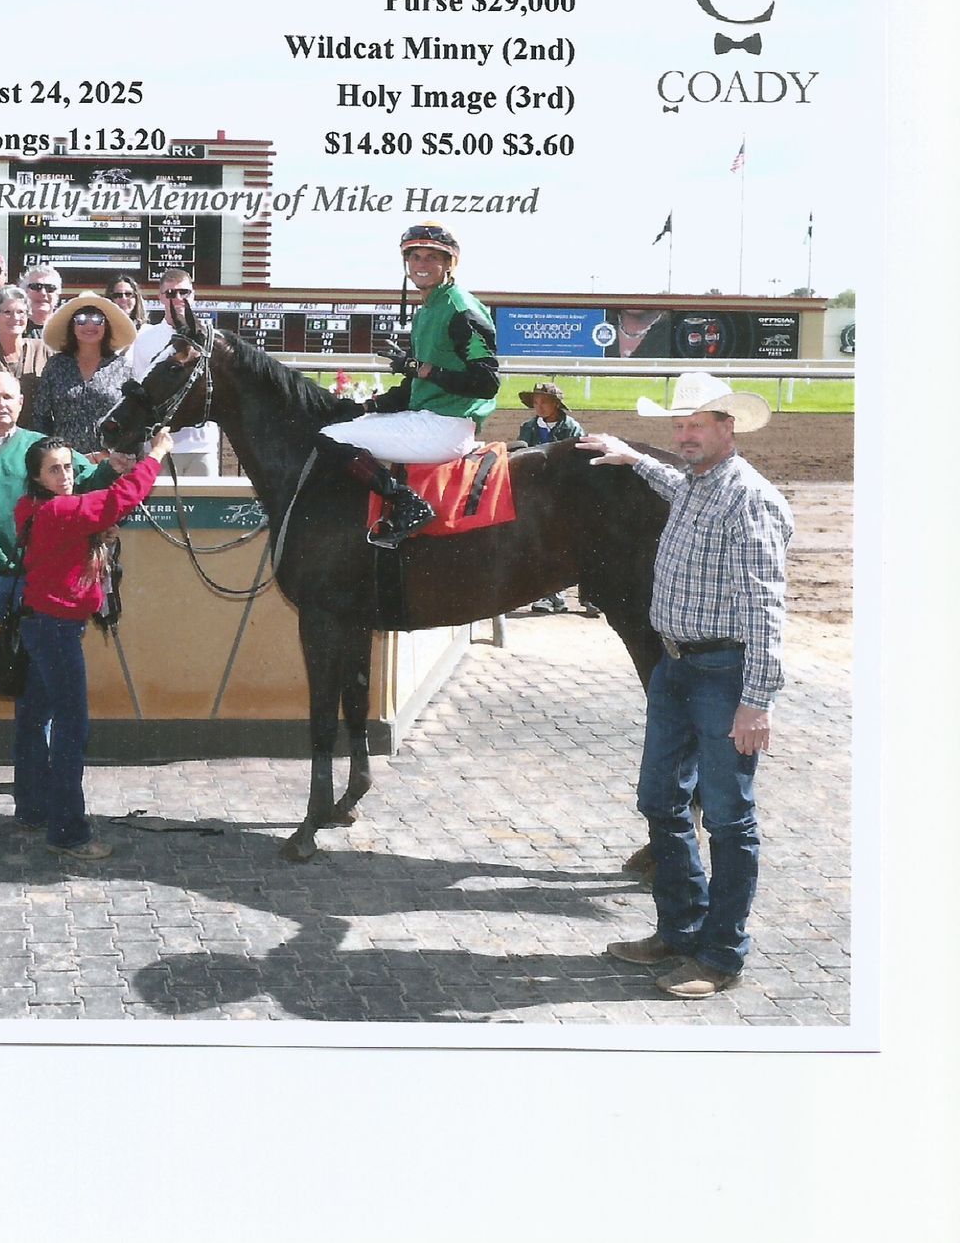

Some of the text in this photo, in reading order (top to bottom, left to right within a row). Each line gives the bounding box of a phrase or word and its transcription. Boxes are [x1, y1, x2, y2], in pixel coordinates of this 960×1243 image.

[30, 233, 80, 244] 5 HOLY IMAGE
[514, 321, 582, 331] continental
